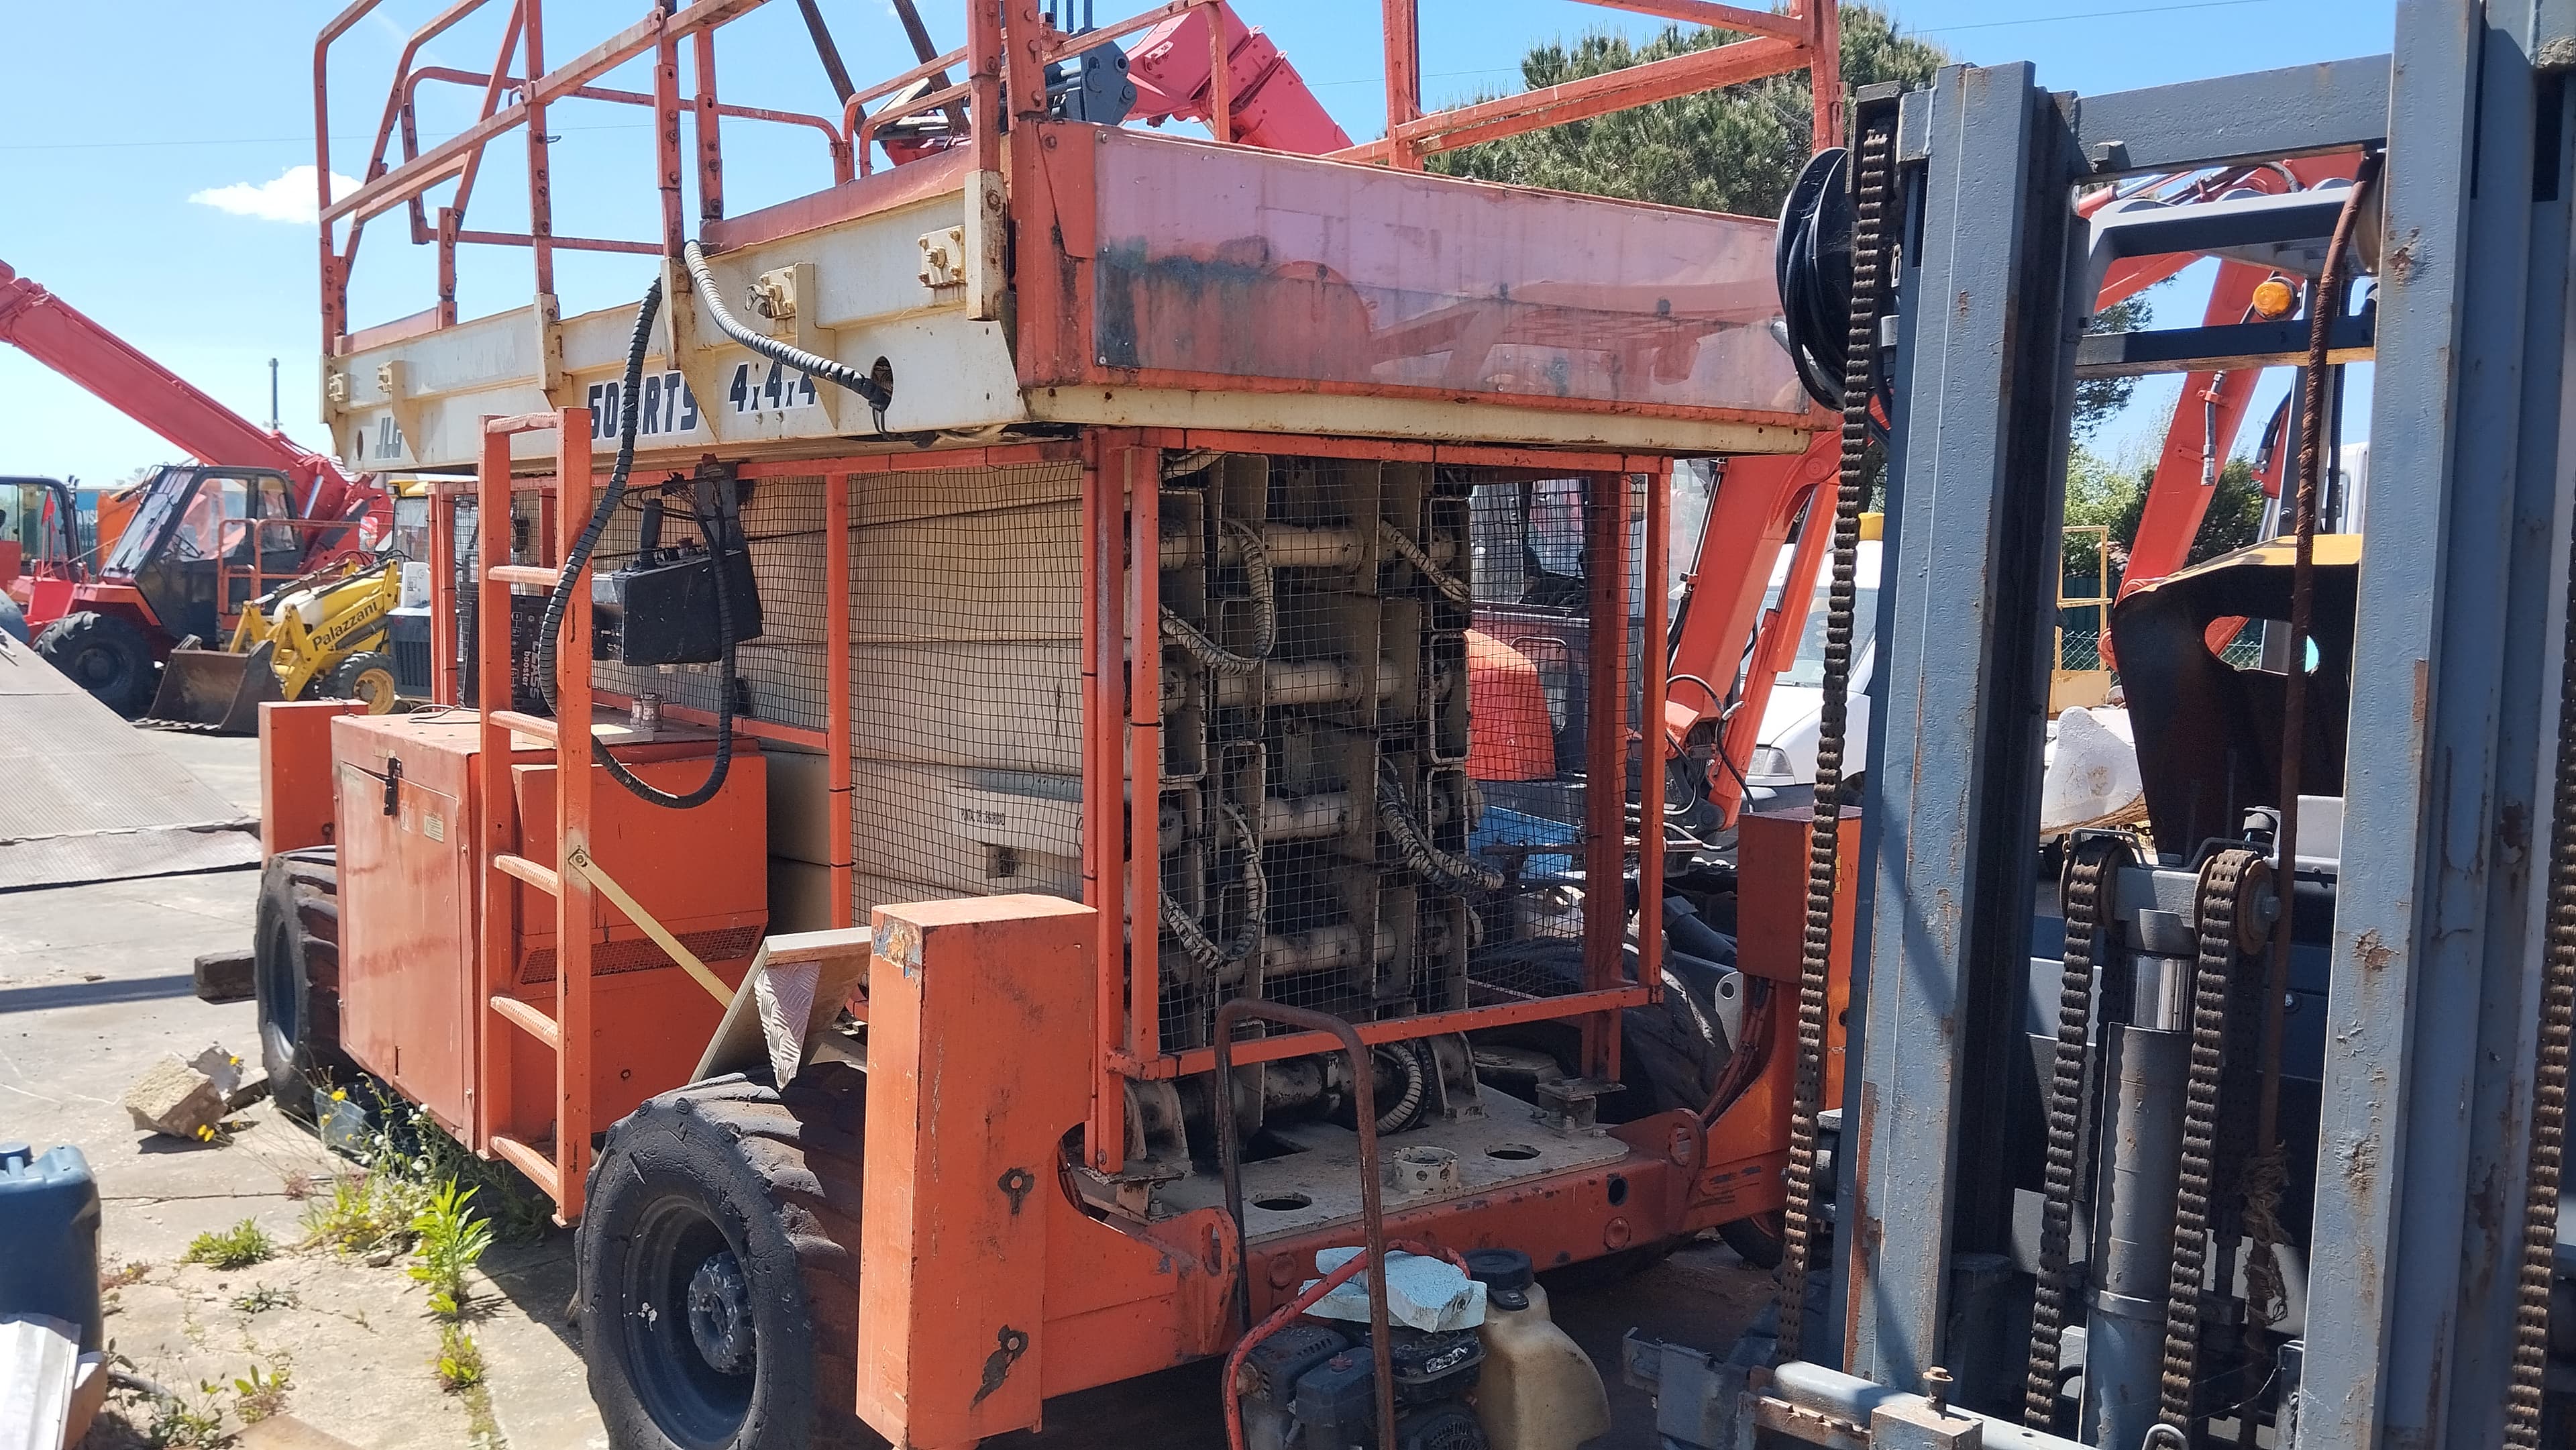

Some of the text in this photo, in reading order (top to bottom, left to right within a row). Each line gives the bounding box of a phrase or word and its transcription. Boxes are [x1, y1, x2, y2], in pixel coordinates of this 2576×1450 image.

[588, 372, 698, 439] 50RTS
[374, 417, 402, 459] JLG
[312, 599, 378, 652] Palazzani
[522, 651, 531, 687] booster
